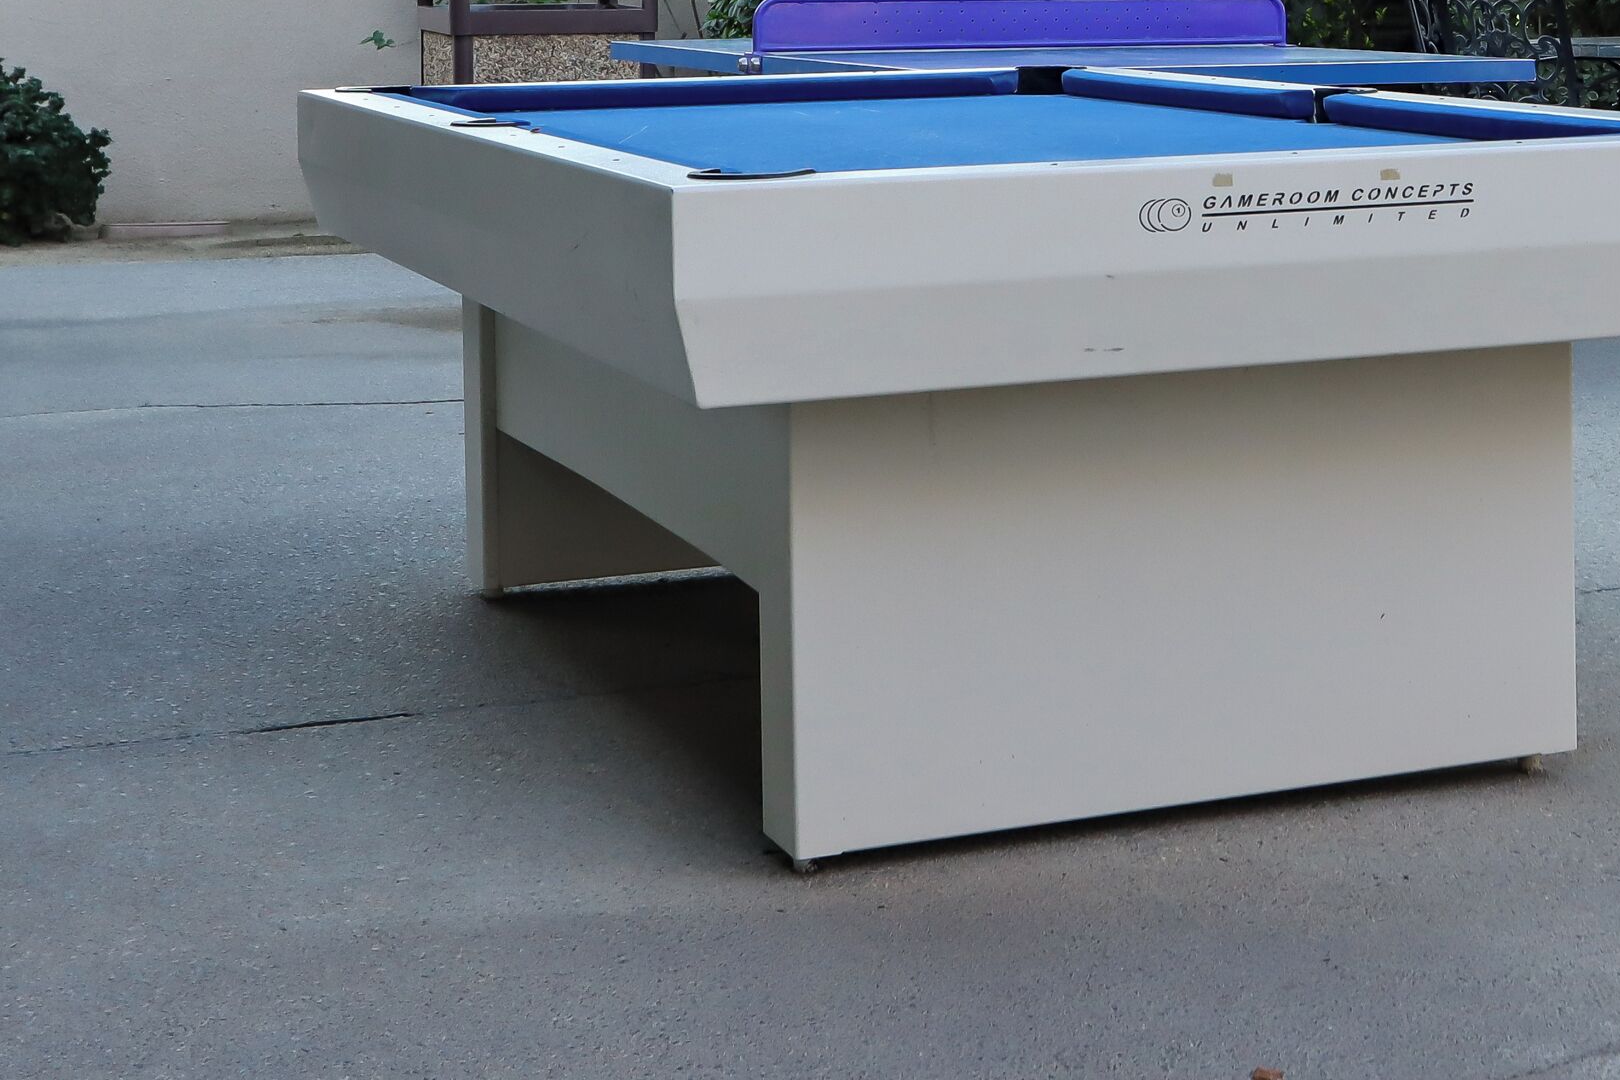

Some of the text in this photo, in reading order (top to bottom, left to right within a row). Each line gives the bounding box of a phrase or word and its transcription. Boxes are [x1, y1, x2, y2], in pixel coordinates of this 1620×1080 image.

[1202, 182, 1474, 210] GAMEROOM CONCEPTS
[1201, 208, 1470, 233] UNLIMITED
